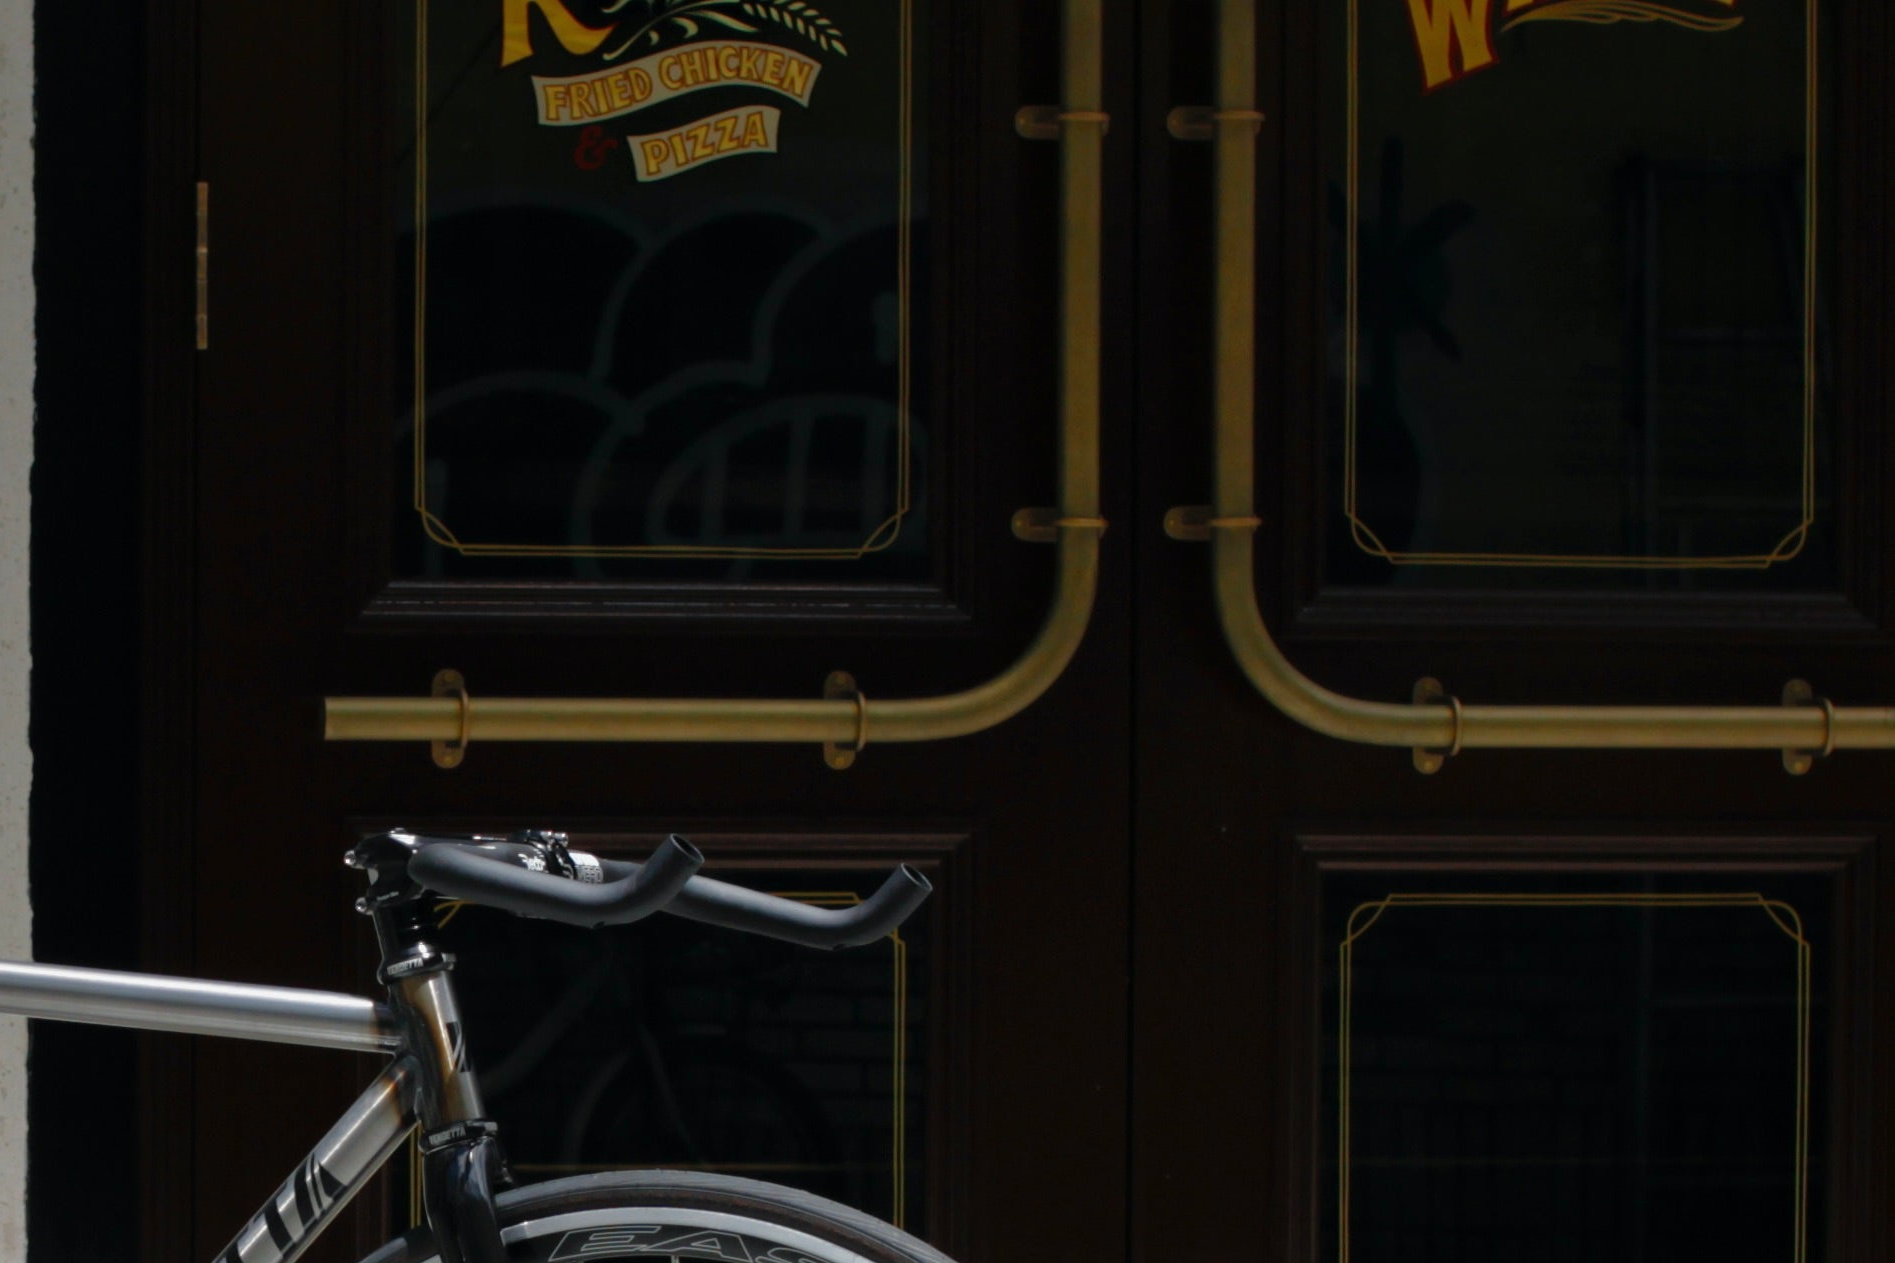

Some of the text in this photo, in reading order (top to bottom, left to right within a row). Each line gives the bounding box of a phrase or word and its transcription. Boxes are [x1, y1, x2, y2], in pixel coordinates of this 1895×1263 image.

[543, 44, 815, 122] FRIED CHICKEN
[573, 111, 771, 177] & PIZZA
